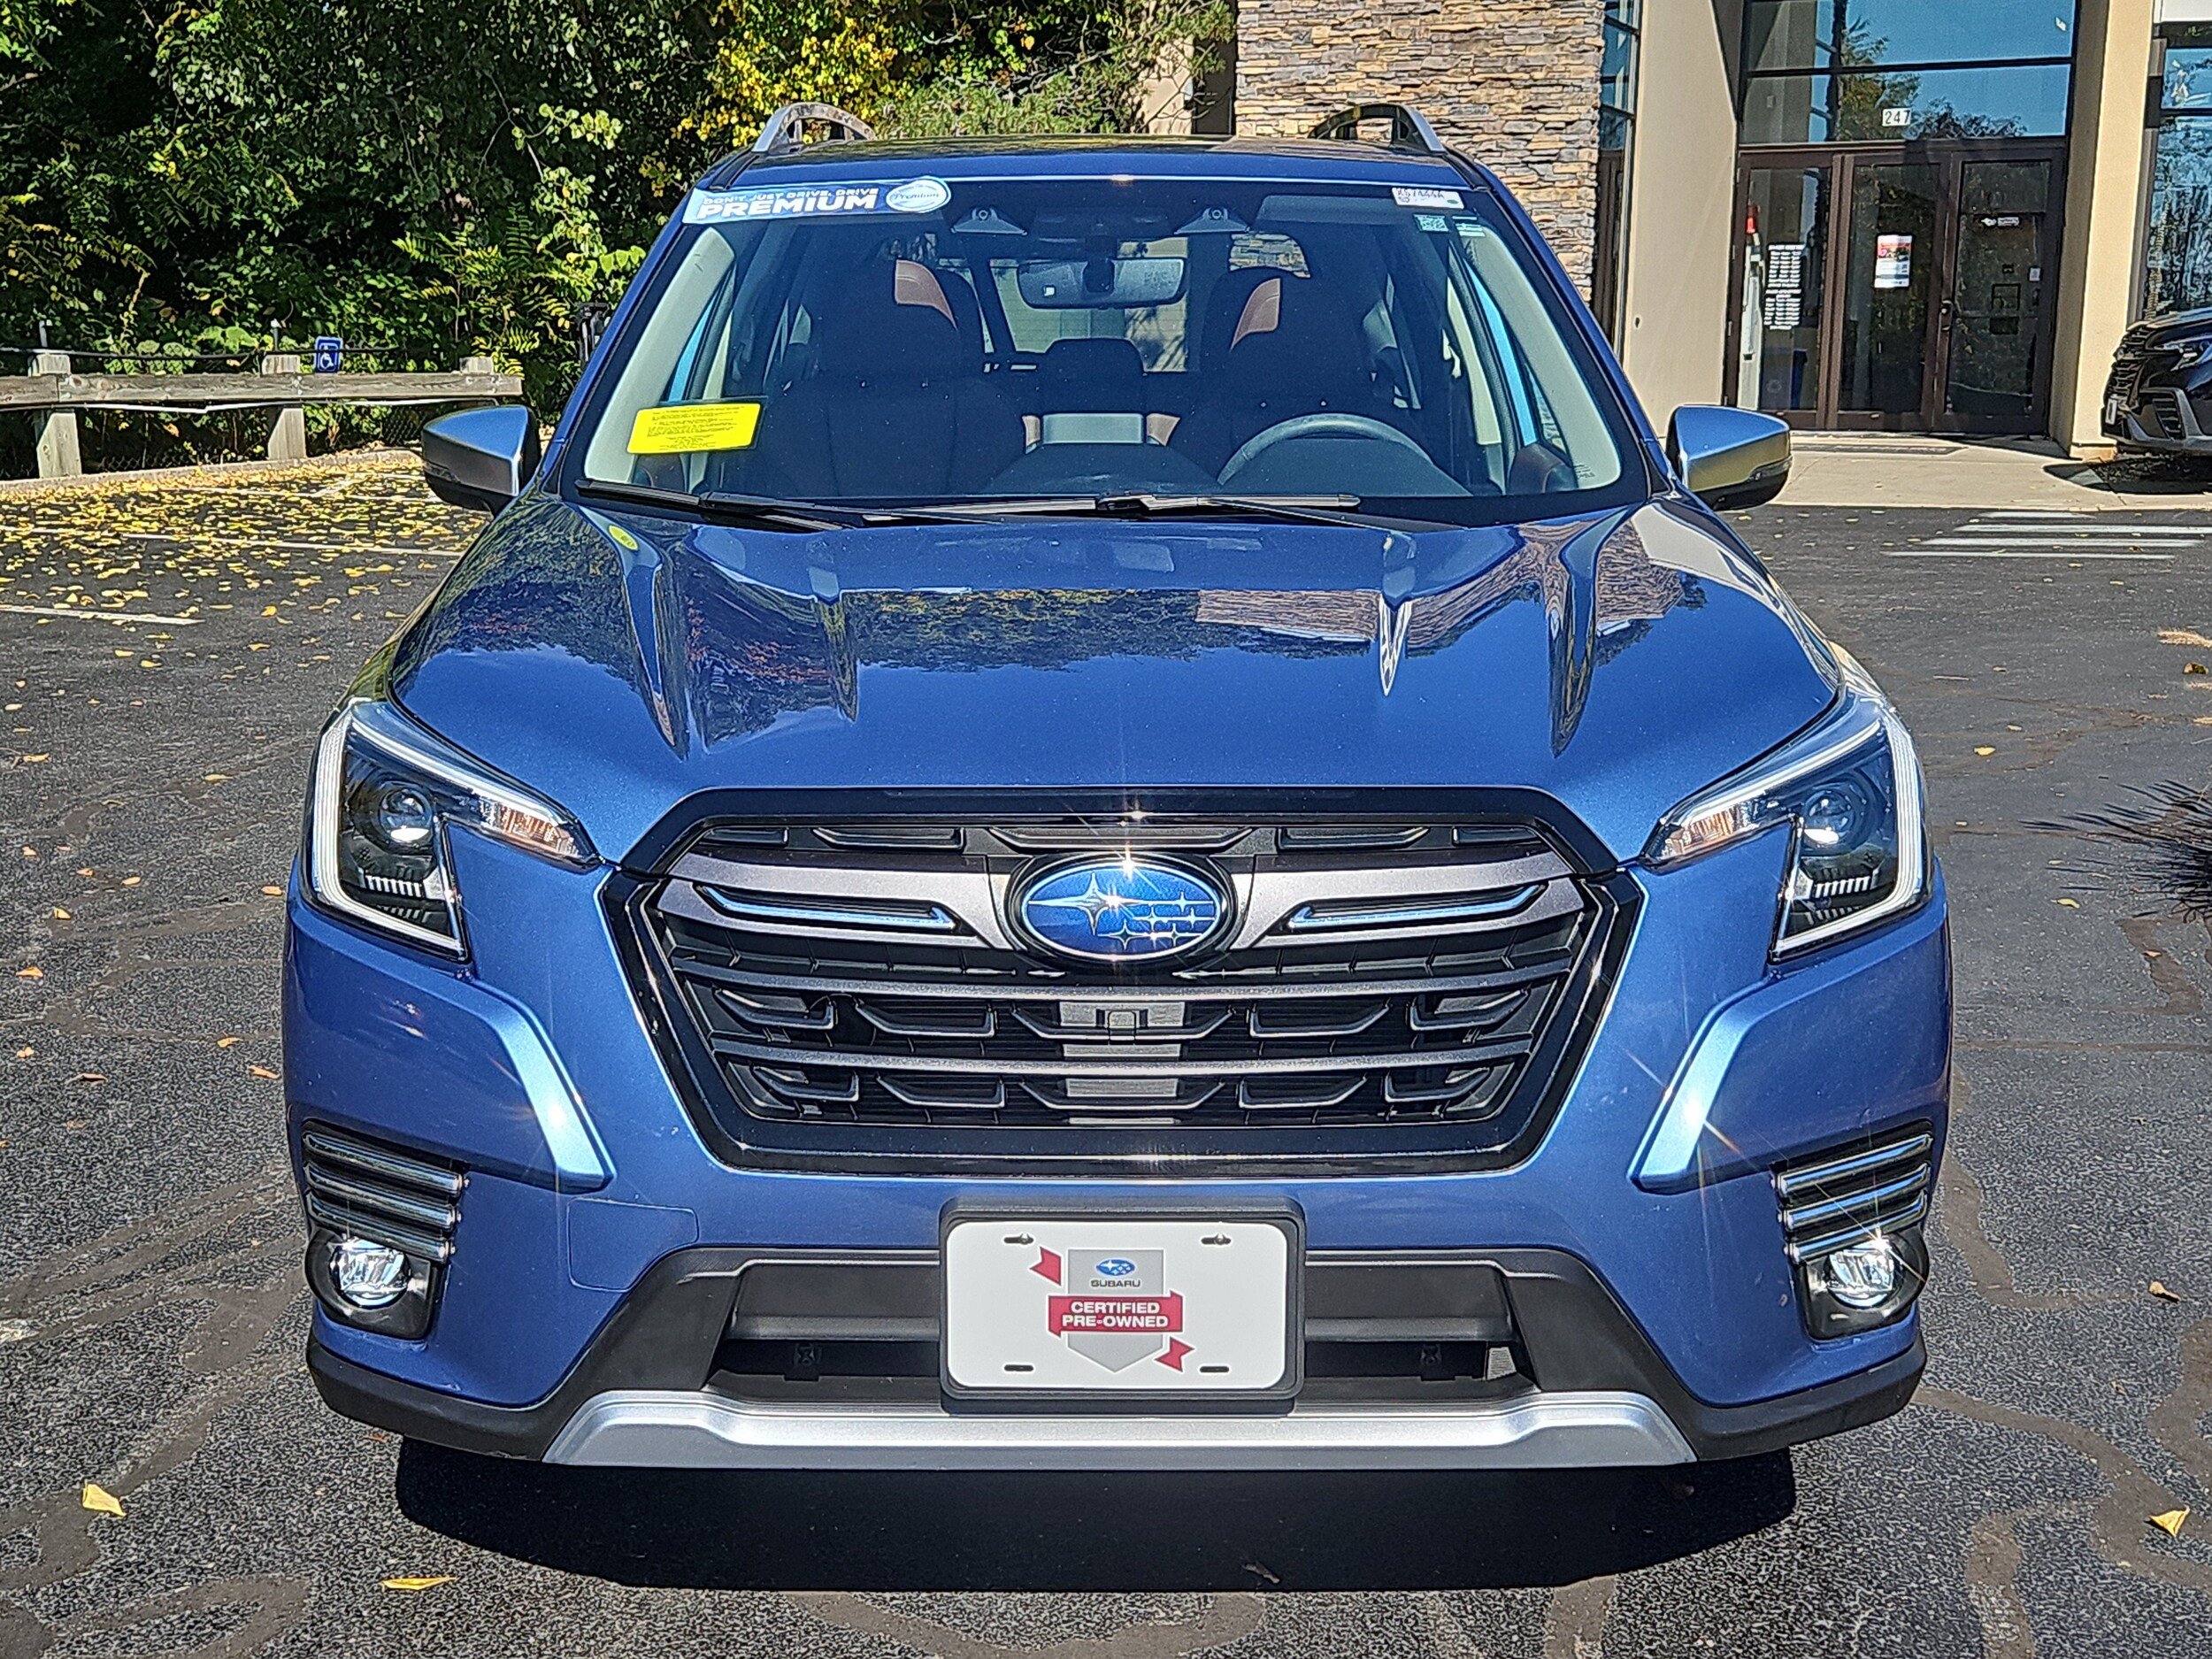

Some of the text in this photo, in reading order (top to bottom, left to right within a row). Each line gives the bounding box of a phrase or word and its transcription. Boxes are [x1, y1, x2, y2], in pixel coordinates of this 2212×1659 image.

[1885, 110, 1911, 125] 247
[835, 187, 879, 196] DRIVE
[696, 194, 878, 219] PREMIUM
[1071, 1302, 1161, 1314] CERTIFIED
[1062, 1315, 1169, 1327] PRE-OWNED
